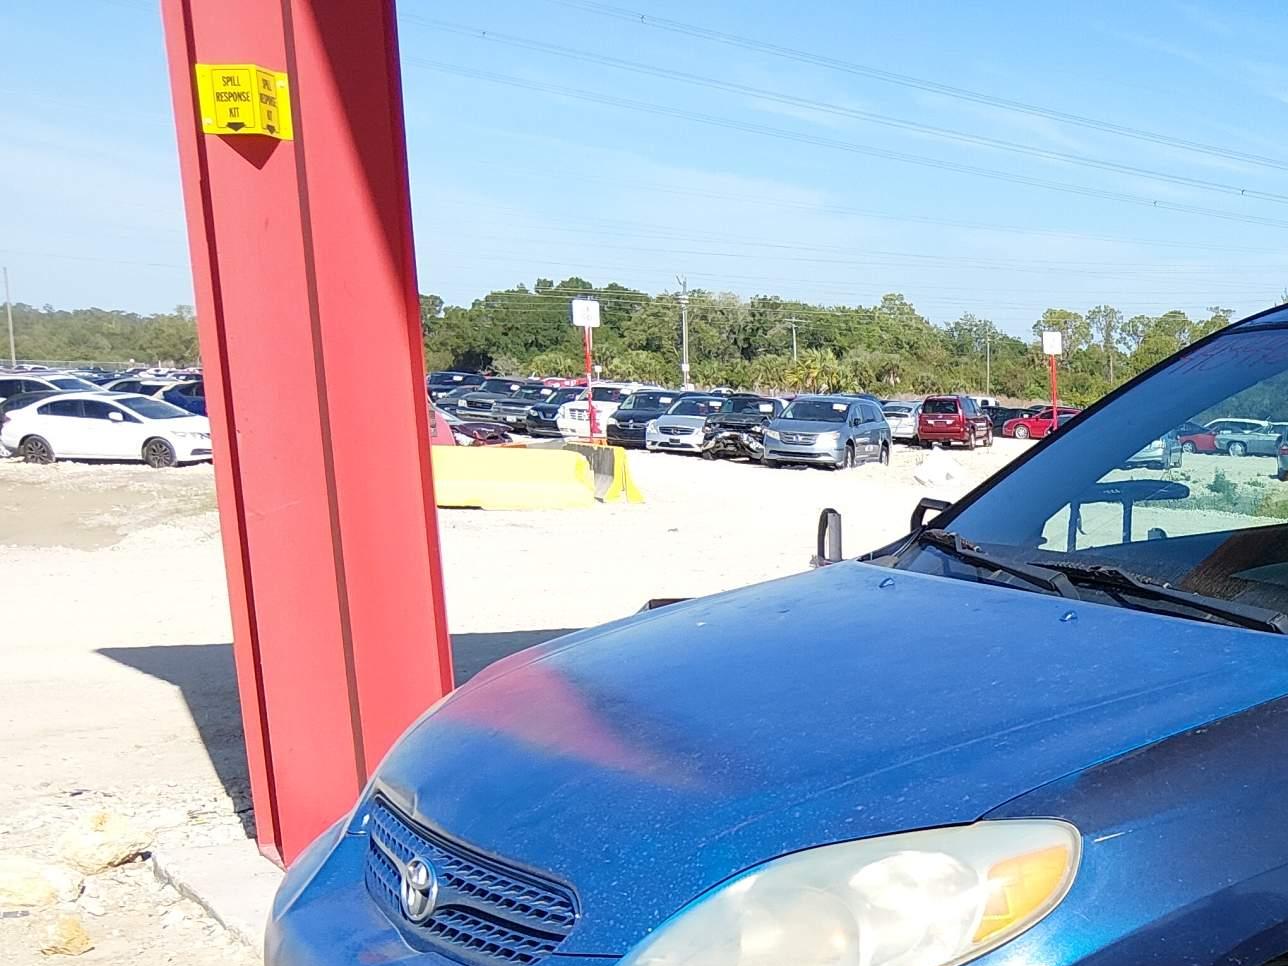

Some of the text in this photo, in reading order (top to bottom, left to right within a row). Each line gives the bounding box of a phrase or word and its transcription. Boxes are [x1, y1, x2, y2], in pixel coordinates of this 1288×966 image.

[222, 75, 240, 87] SPILL
[215, 91, 250, 103] RESPONSE
[228, 107, 240, 118] KIT
